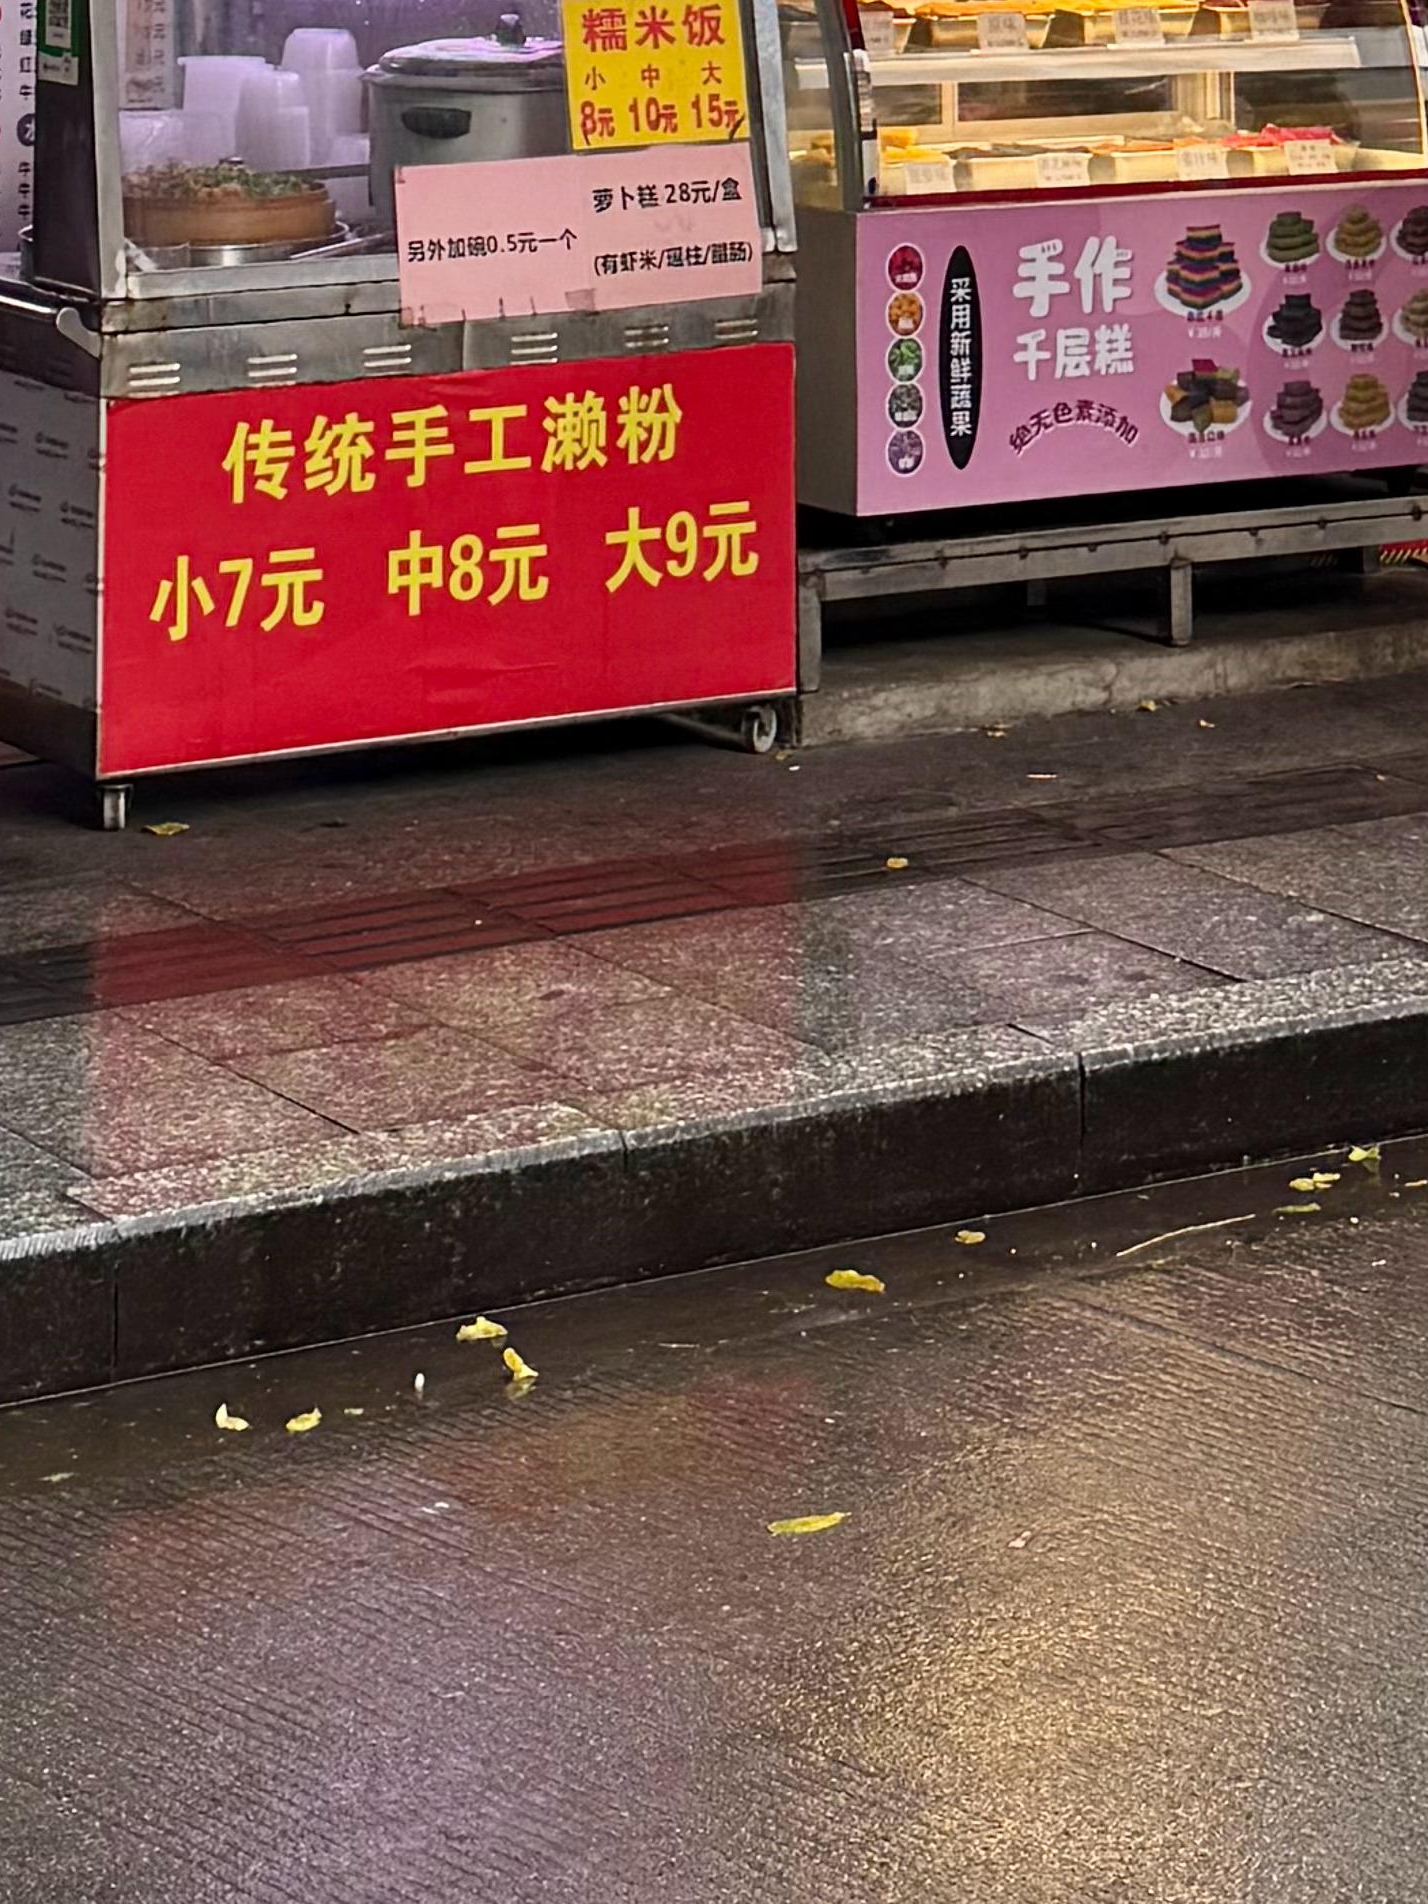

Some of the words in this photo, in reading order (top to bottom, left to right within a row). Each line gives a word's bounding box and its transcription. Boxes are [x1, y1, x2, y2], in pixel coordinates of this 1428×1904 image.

[581, 3, 726, 53] 糯米饭
[584, 66, 606, 91] 小
[640, 64, 661, 89] 中
[701, 60, 723, 85] 大
[580, 100, 616, 138] 8元
[628, 96, 679, 135] 10元
[691, 93, 741, 130] 15元
[591, 185, 662, 214] 萝卜糕
[664, 177, 743, 205] 28元/盒
[407, 228, 578, 263] 另外加碗0.5元一个
[1012, 234, 1133, 319] 手作
[949, 276, 973, 438] 采用新鲜蔬果
[1012, 322, 1135, 382] 千层糕
[222, 382, 683, 505] 传统手工濑粉
[1009, 398, 1140, 456] 绝无色素添加
[149, 547, 326, 642] 小7元
[387, 523, 550, 617] 中8元
[604, 499, 759, 594] 大9元
